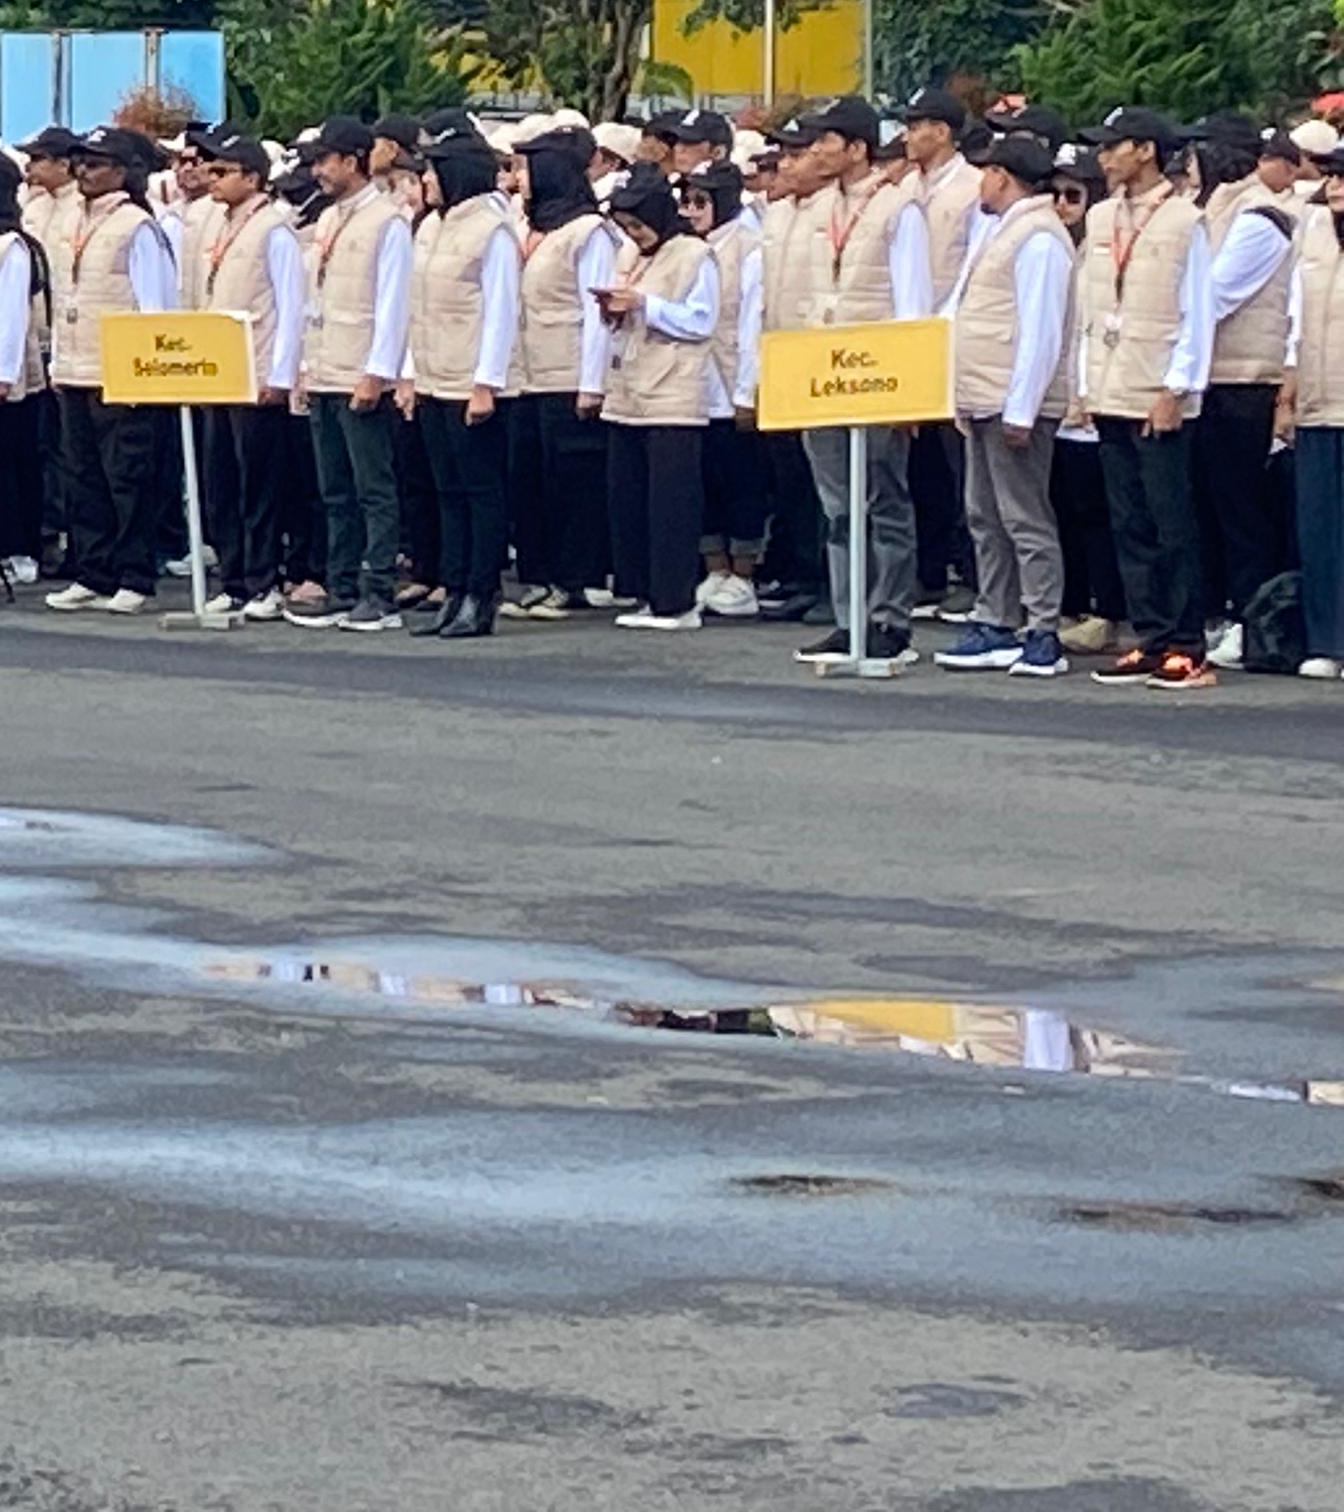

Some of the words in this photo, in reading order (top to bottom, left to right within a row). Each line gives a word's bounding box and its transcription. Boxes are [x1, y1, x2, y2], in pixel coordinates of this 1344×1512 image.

[154, 334, 193, 352] Kec.
[132, 357, 218, 377] Selomerto
[831, 348, 880, 370] Kec.
[810, 375, 899, 398] Leksono
